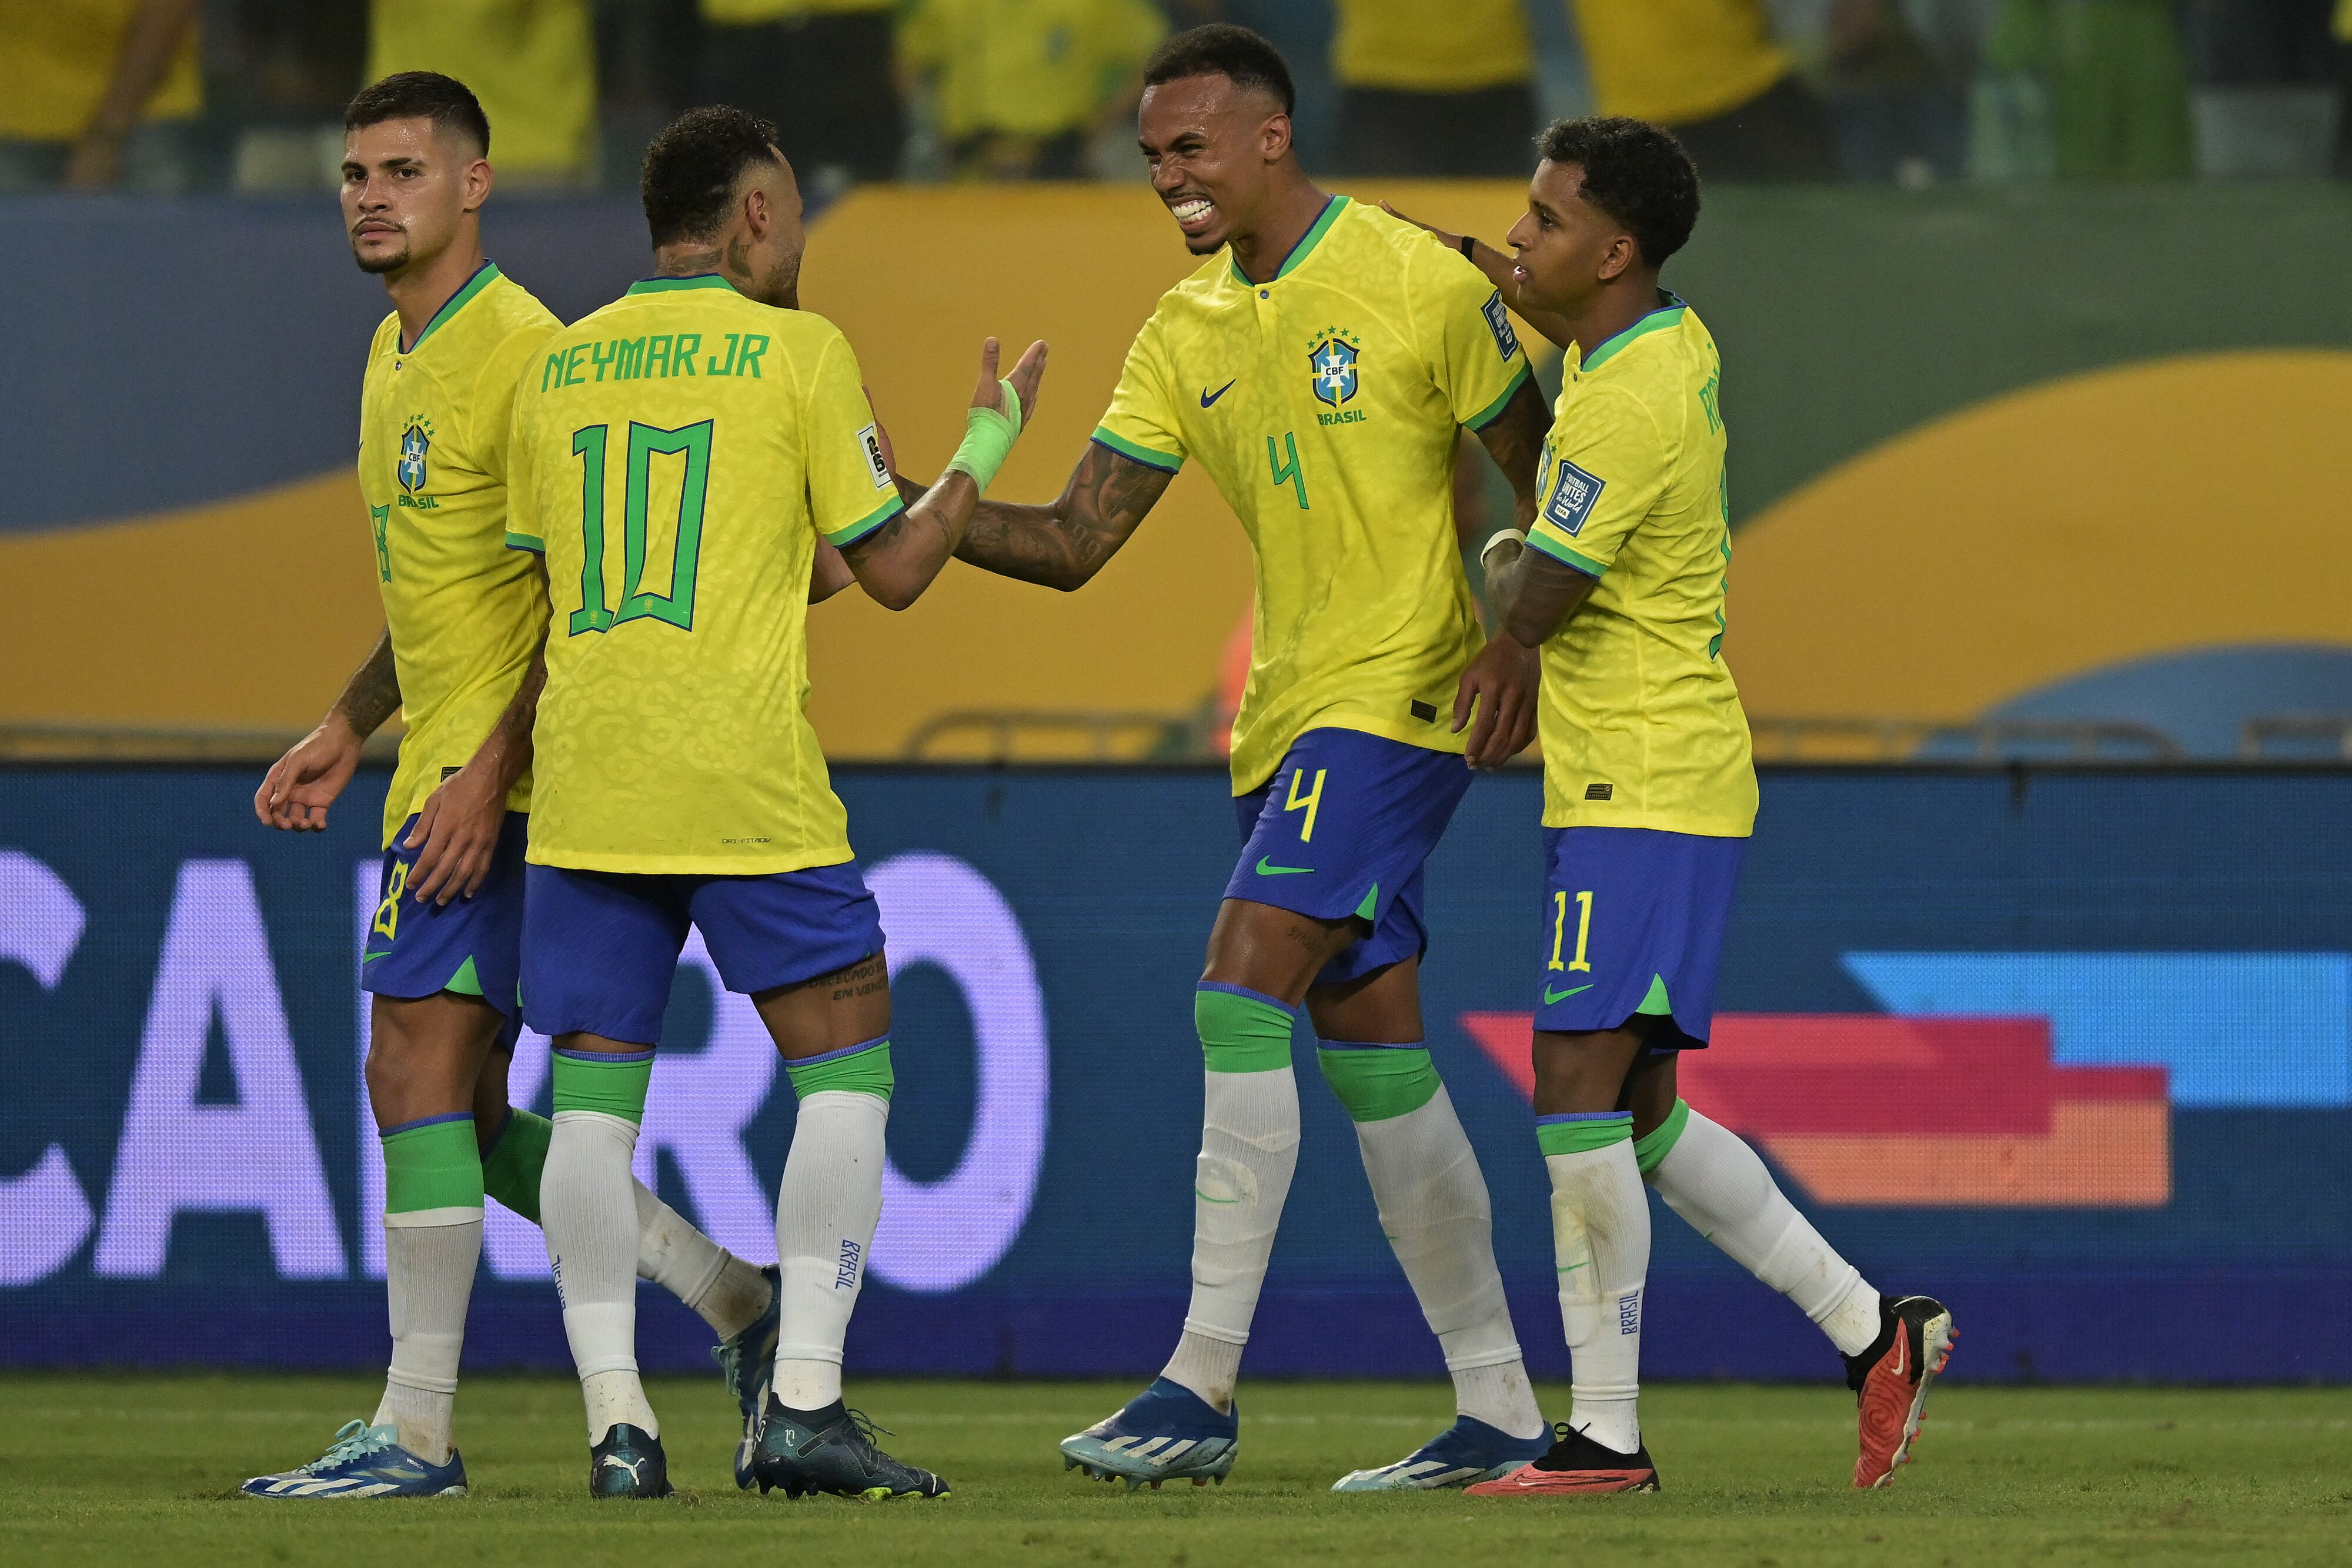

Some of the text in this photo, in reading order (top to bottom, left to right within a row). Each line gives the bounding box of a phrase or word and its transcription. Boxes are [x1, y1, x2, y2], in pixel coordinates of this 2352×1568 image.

[541, 333, 770, 393] NEYMAR JR
[1325, 366, 1344, 376] CBF
[1317, 409, 1368, 426] BRASIL
[409, 453, 421, 463] CBF
[1267, 431, 1310, 510] 4
[398, 494, 439, 510] BRASIL
[568, 418, 714, 637] 10
[1284, 768, 1328, 843] 4
[373, 858, 409, 941] 8
[1548, 890, 1593, 973] 11
[835, 1239, 861, 1289] BRASIL
[1619, 1289, 1639, 1336] BRASIL
